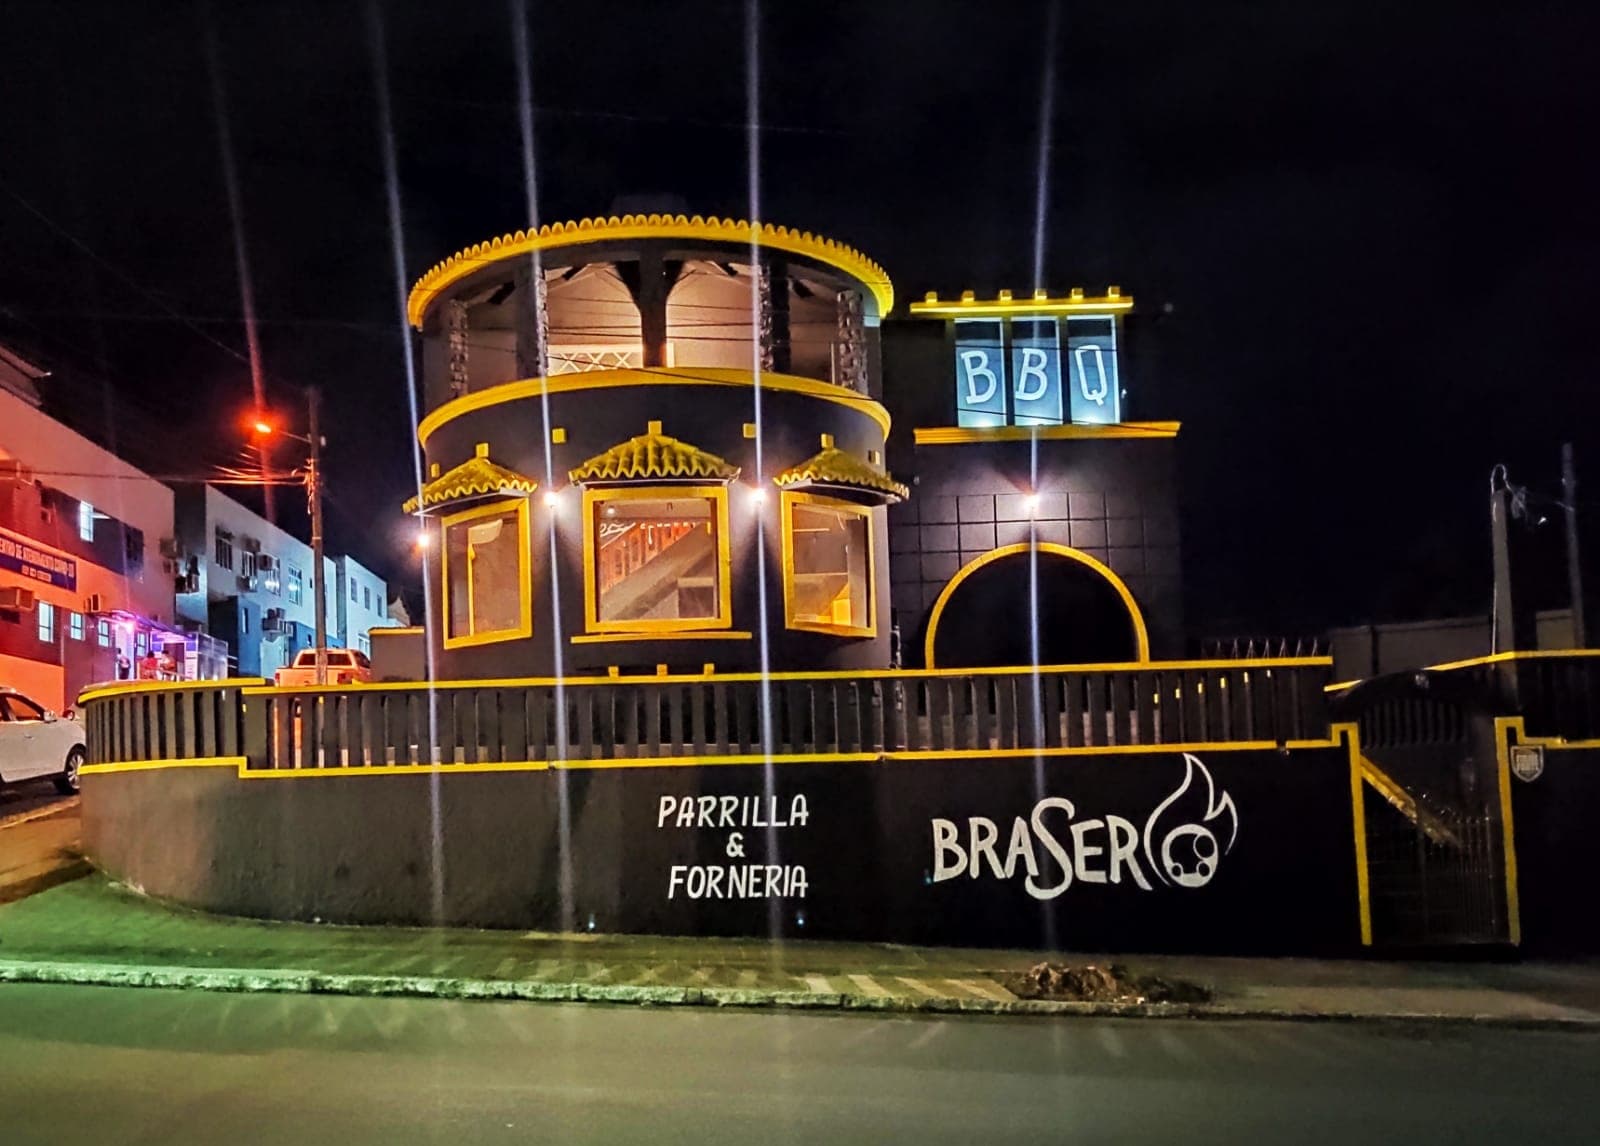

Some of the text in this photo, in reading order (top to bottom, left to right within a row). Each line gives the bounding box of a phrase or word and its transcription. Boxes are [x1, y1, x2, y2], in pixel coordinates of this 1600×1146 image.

[961, 344, 1108, 406] BBQ
[657, 794, 809, 828] PARRILLA
[725, 832, 746, 858] &
[668, 865, 808, 899] FORNERIA
